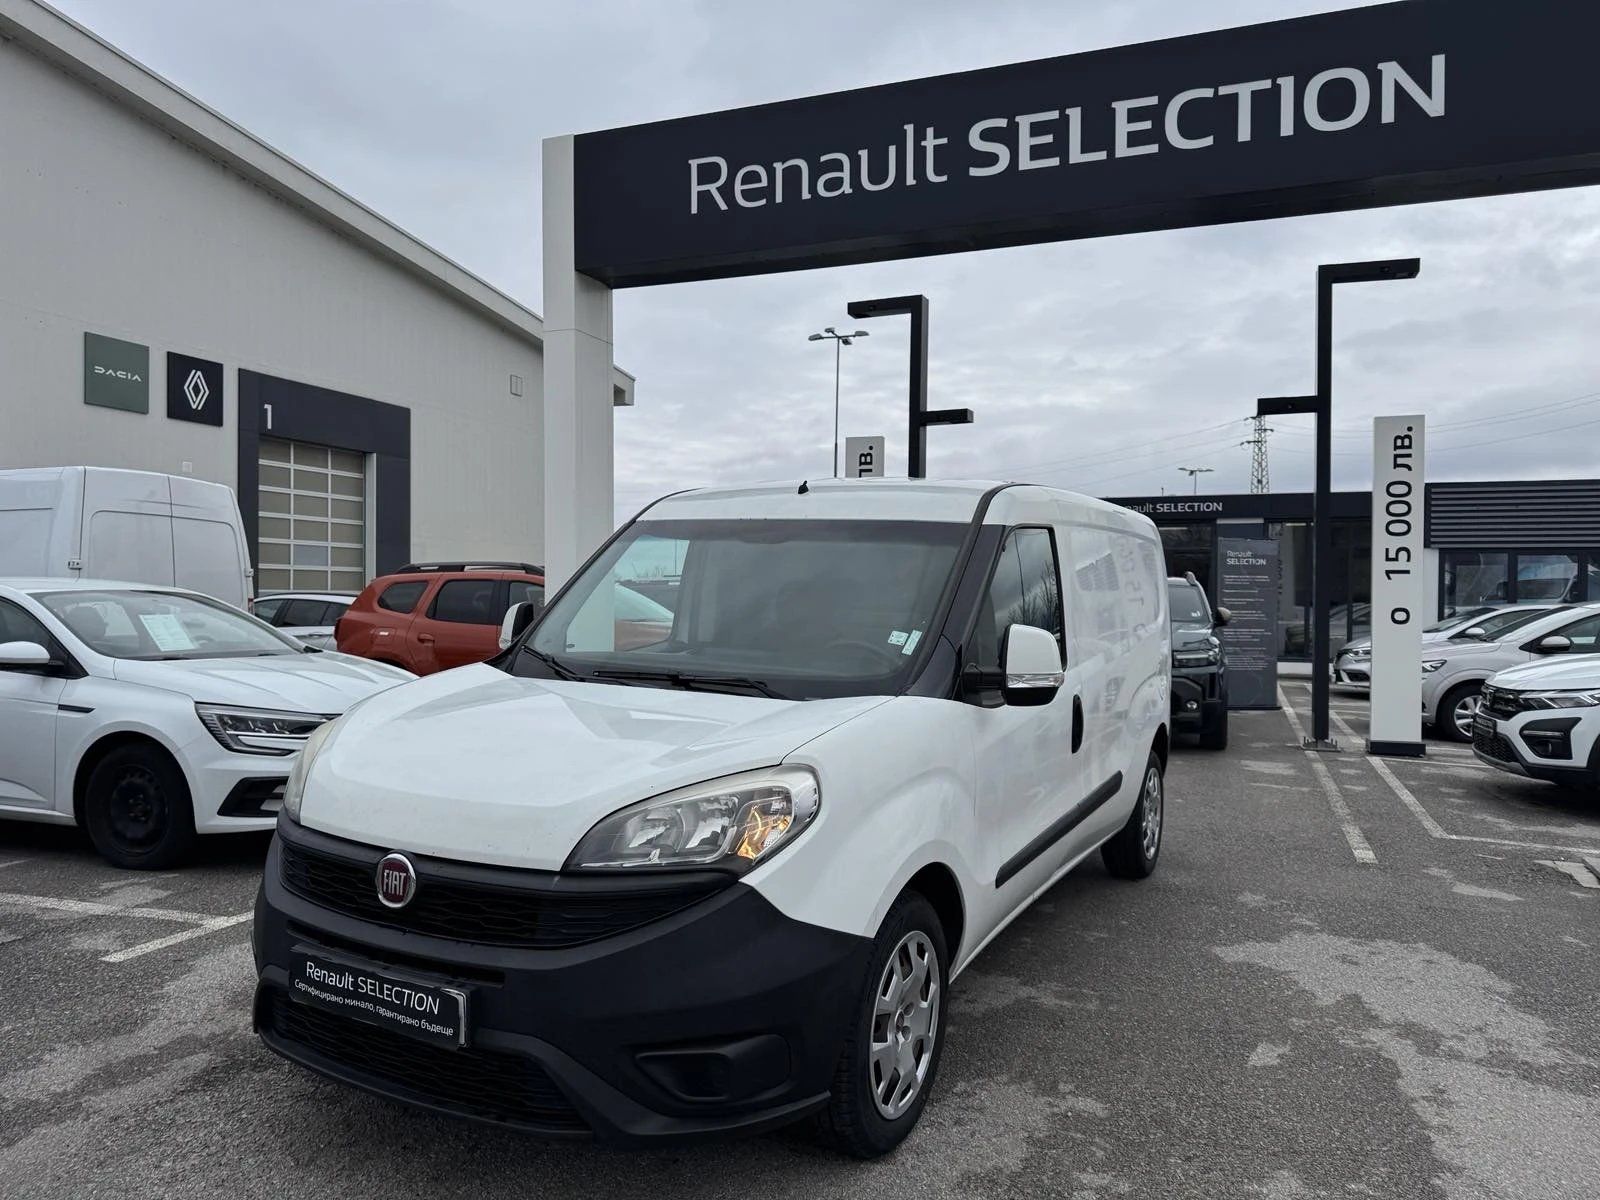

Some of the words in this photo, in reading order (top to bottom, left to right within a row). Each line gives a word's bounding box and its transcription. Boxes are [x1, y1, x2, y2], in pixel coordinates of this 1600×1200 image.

[687, 123, 948, 214] Renault
[968, 54, 1446, 177] SELECTION
[94, 365, 142, 382] DACIA
[263, 403, 272, 430] 1
[1393, 426, 1413, 471] лв.
[1156, 502, 1223, 513] SELECTION
[1385, 480, 1412, 537] 000
[1226, 558, 1267, 566] SELECTION
[1385, 546, 1411, 580] 15
[384, 869, 407, 896] FIAT
[306, 961, 355, 991] Renault
[358, 976, 440, 1015] SELECTION
[294, 978, 344, 1004] Сертифицирано
[375, 1004, 420, 1028] гарантирано
[421, 1018, 454, 1037] бъдеще
